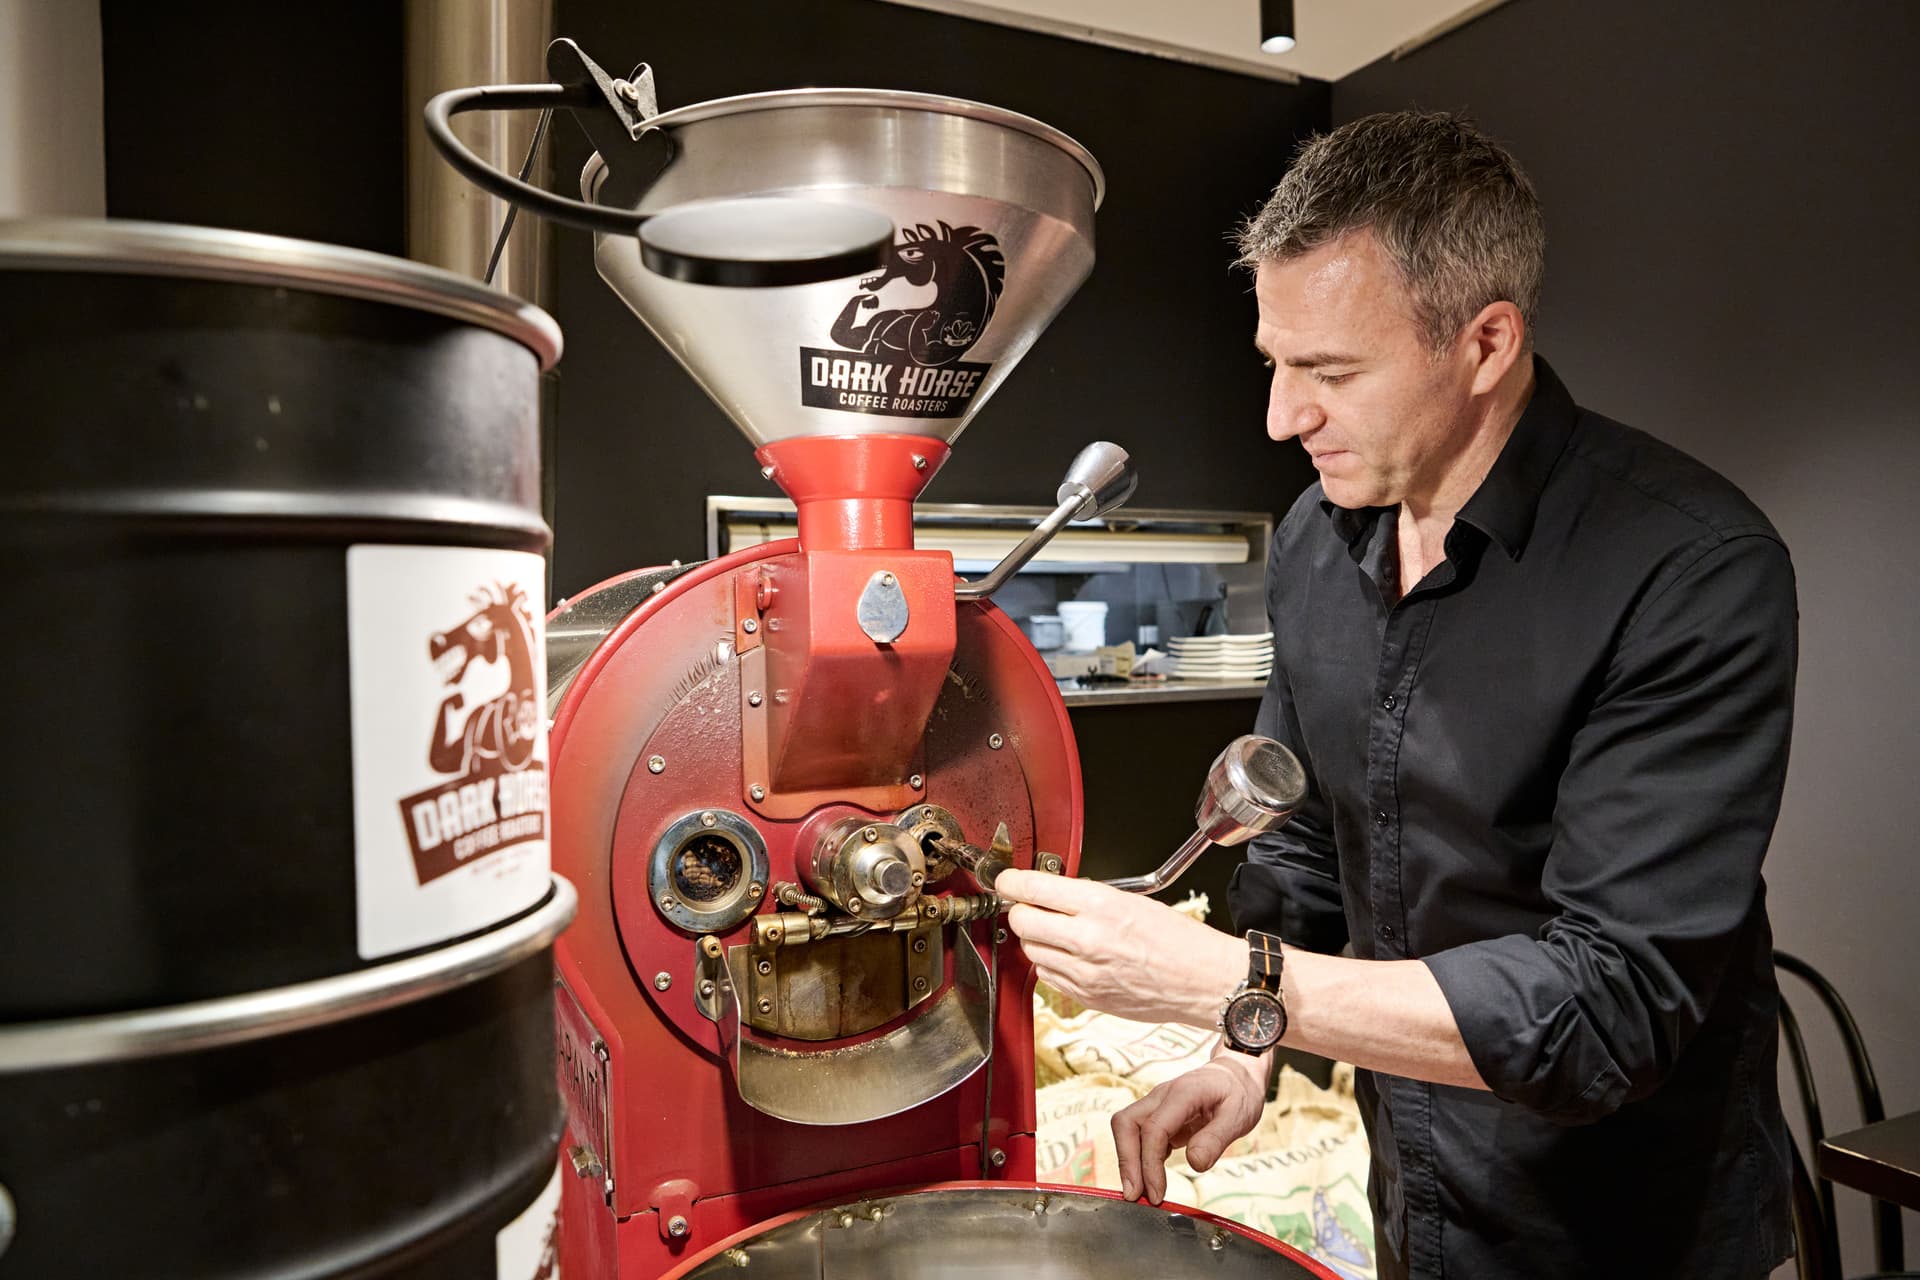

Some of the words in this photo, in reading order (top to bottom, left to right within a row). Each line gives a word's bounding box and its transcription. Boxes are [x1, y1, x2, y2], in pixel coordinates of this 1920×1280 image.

[811, 357, 893, 393] DARK
[899, 366, 981, 397] HORSE
[840, 392, 888, 409] COFFEE
[892, 398, 948, 412] ROASTERS
[412, 777, 497, 852] DARK
